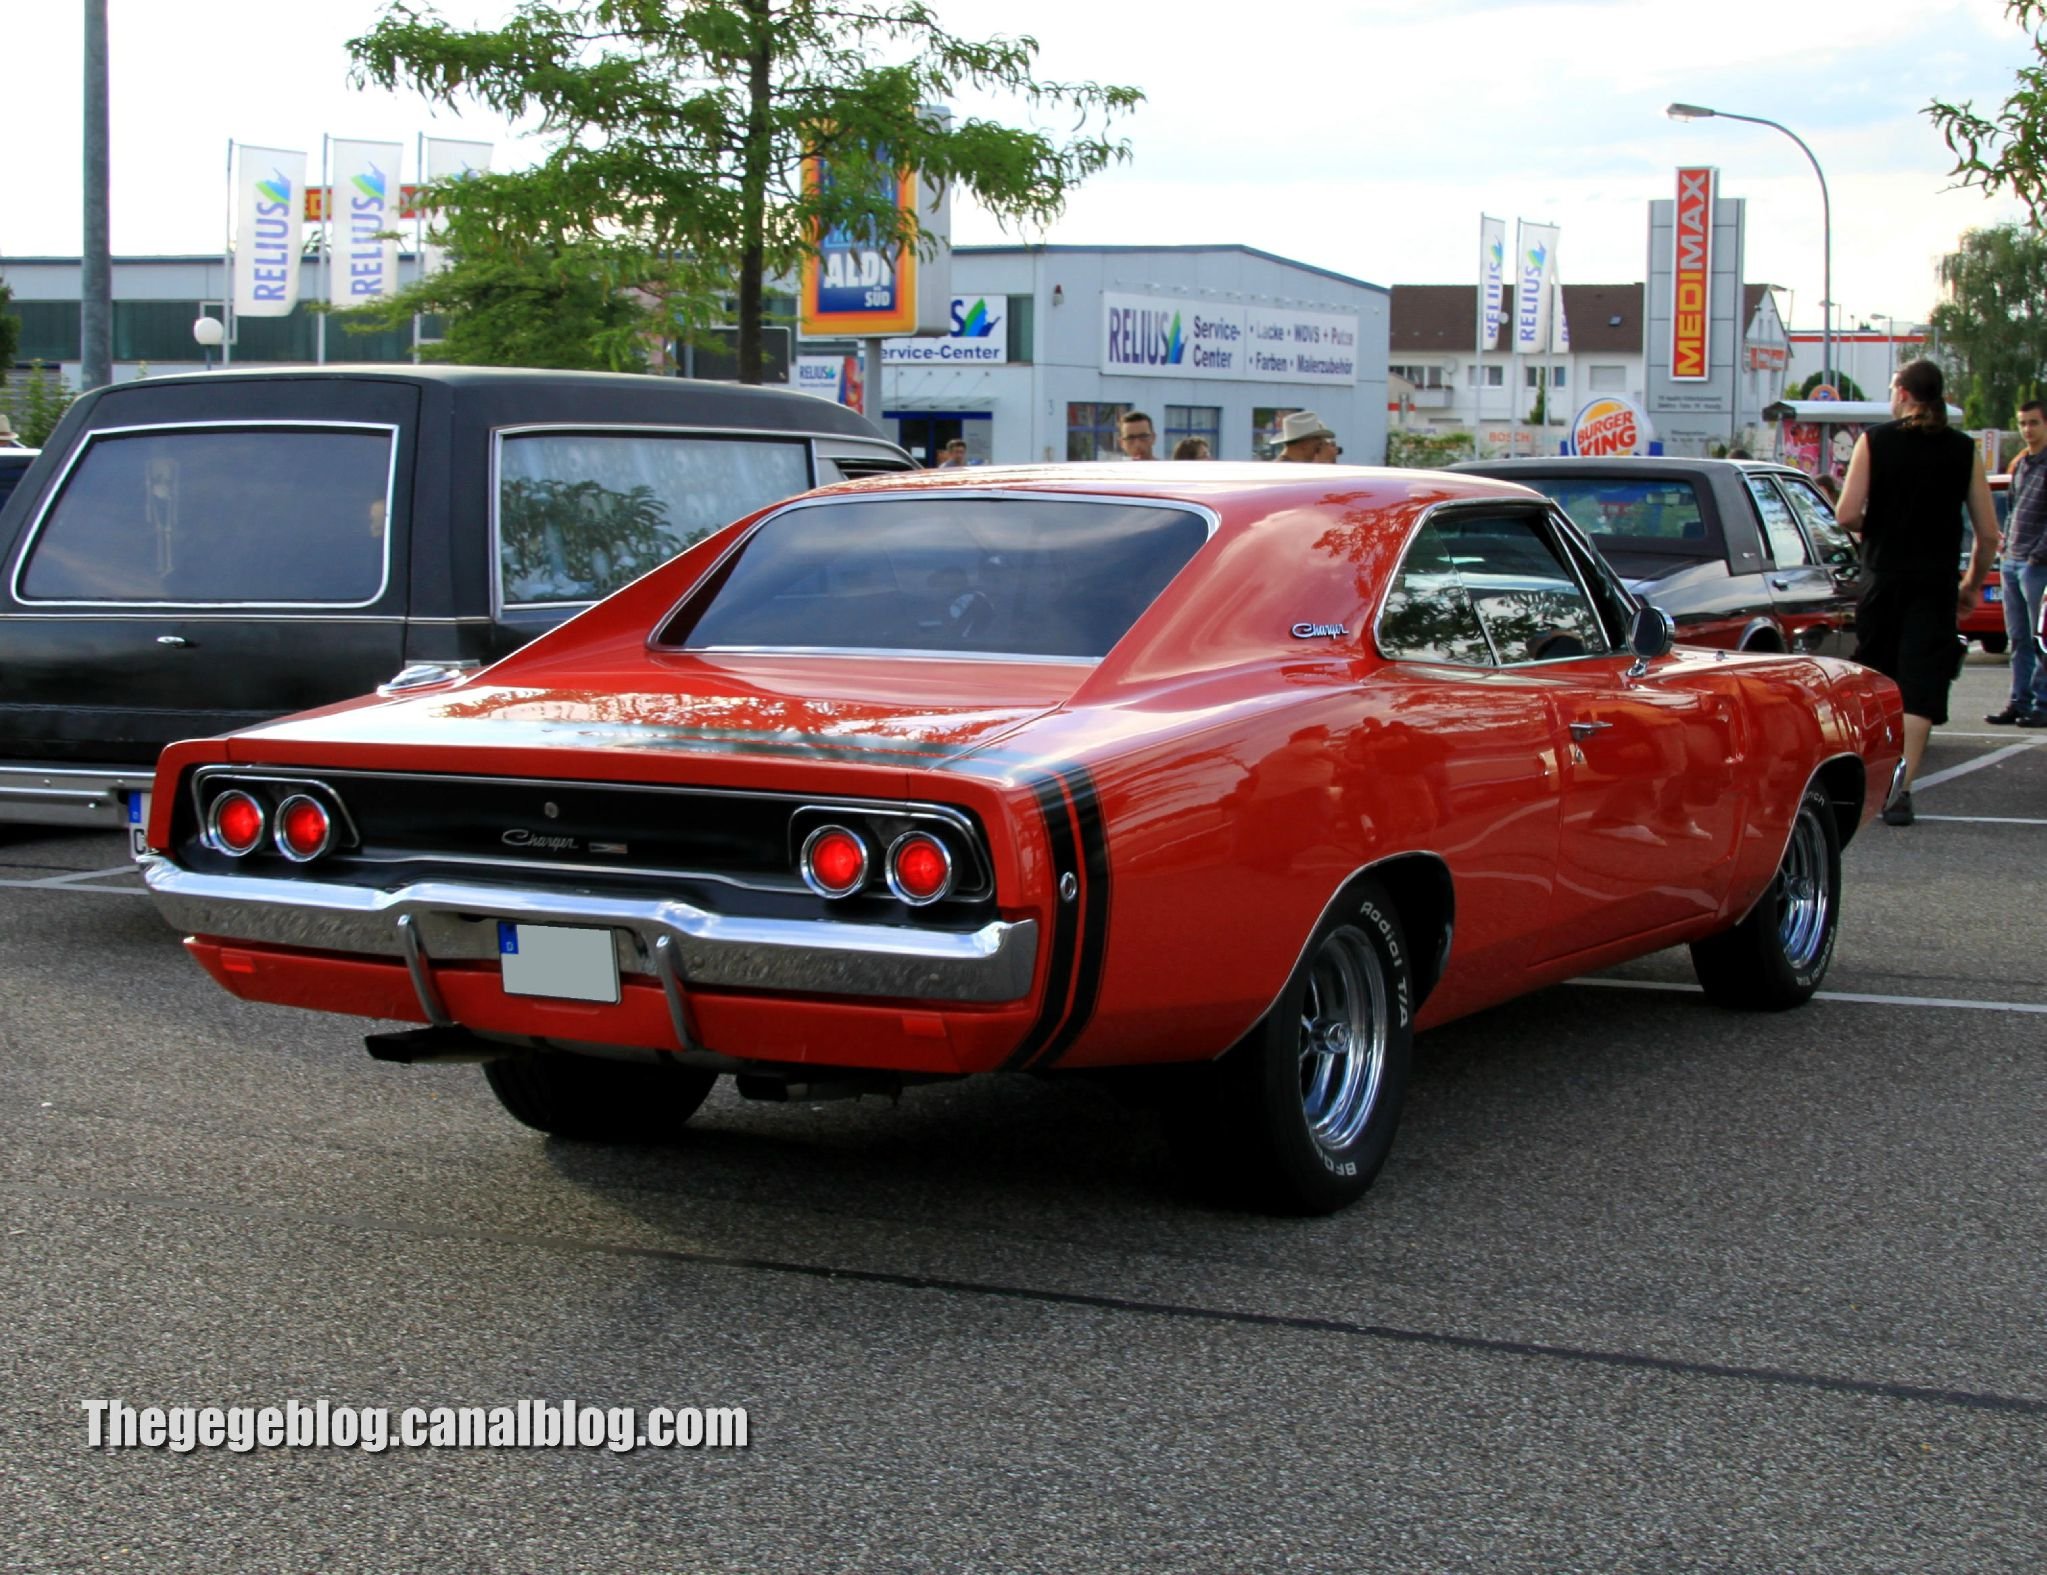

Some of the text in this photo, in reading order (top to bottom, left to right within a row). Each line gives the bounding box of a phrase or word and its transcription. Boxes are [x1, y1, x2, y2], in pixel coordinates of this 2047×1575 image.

[253, 201, 289, 301] RELIUS
[351, 196, 385, 296] RELIUS
[823, 252, 892, 289] ALDI
[1677, 173, 1707, 376] MEDIMAX
[864, 286, 891, 307] SÜD
[1519, 265, 1543, 342] RELIUS
[1108, 307, 1170, 366] RELIUS
[1193, 315, 1241, 342] Service-
[881, 345, 1000, 360] ervice-Center
[1193, 343, 1233, 369] Center
[1256, 351, 1288, 372] Farben
[799, 365, 828, 379] RELIUS
[1489, 431, 1531, 443] BOSCH
[1577, 410, 1633, 446] BURGER
[1580, 425, 1636, 456] KING
[500, 828, 580, 856] Charger
[505, 941, 514, 952] D
[1359, 900, 1409, 1029] Radial T/A
